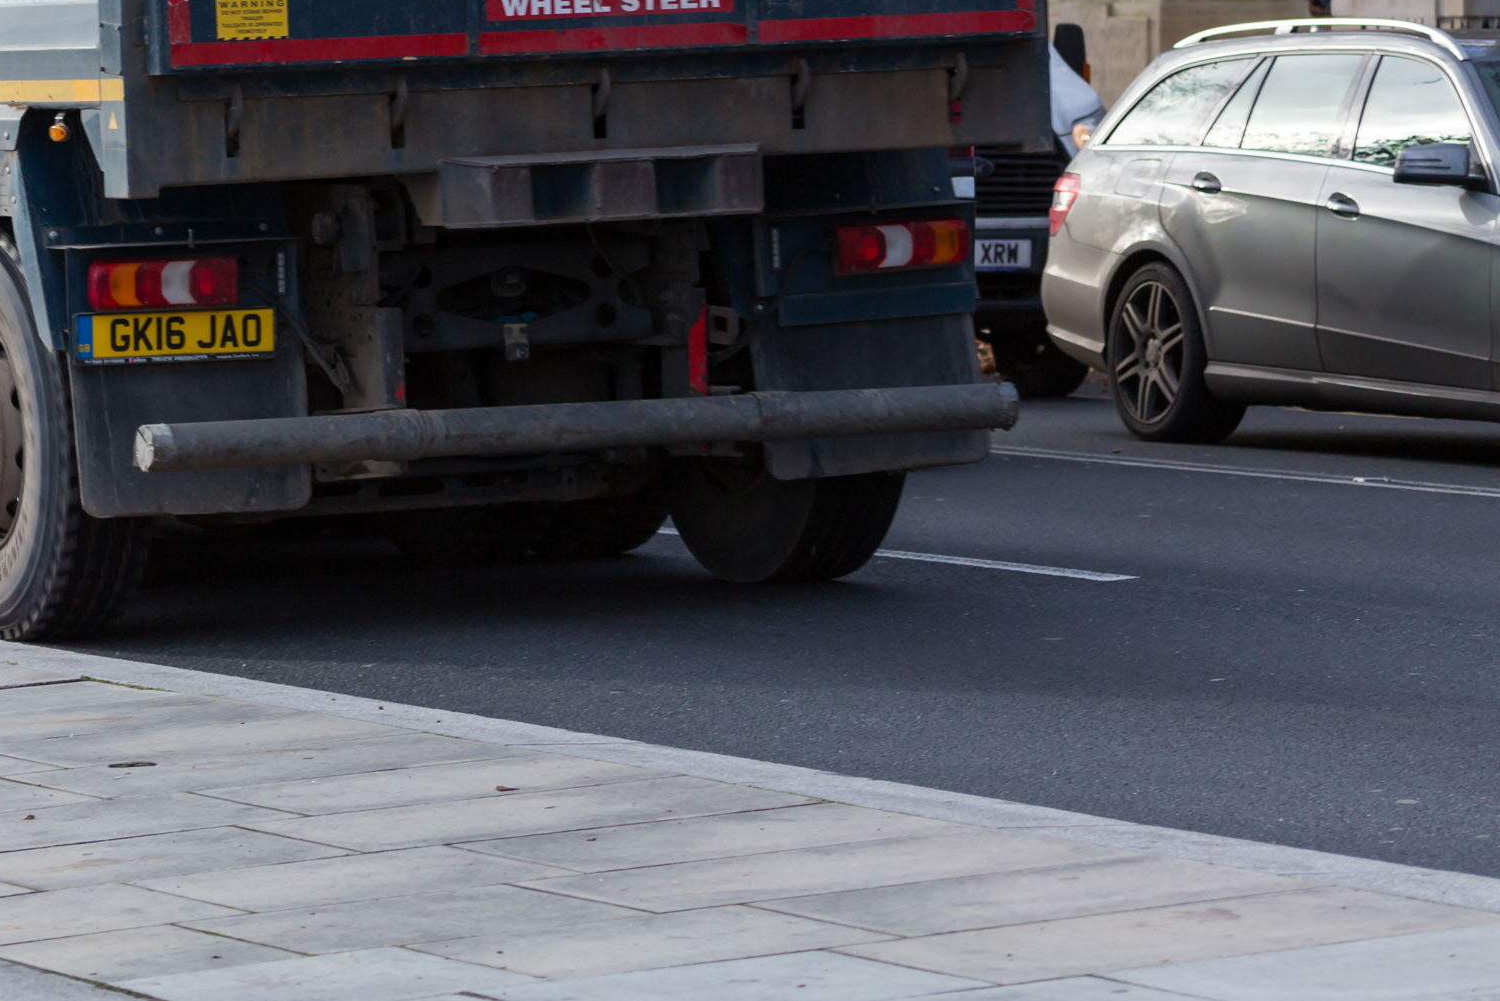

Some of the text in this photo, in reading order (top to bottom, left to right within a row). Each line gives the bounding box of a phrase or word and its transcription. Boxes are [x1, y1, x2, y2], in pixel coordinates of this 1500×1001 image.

[218, 0, 284, 8] WARNING
[981, 243, 1019, 264] XRW
[110, 313, 262, 352] GK16 JAO
[78, 343, 91, 353] GB
